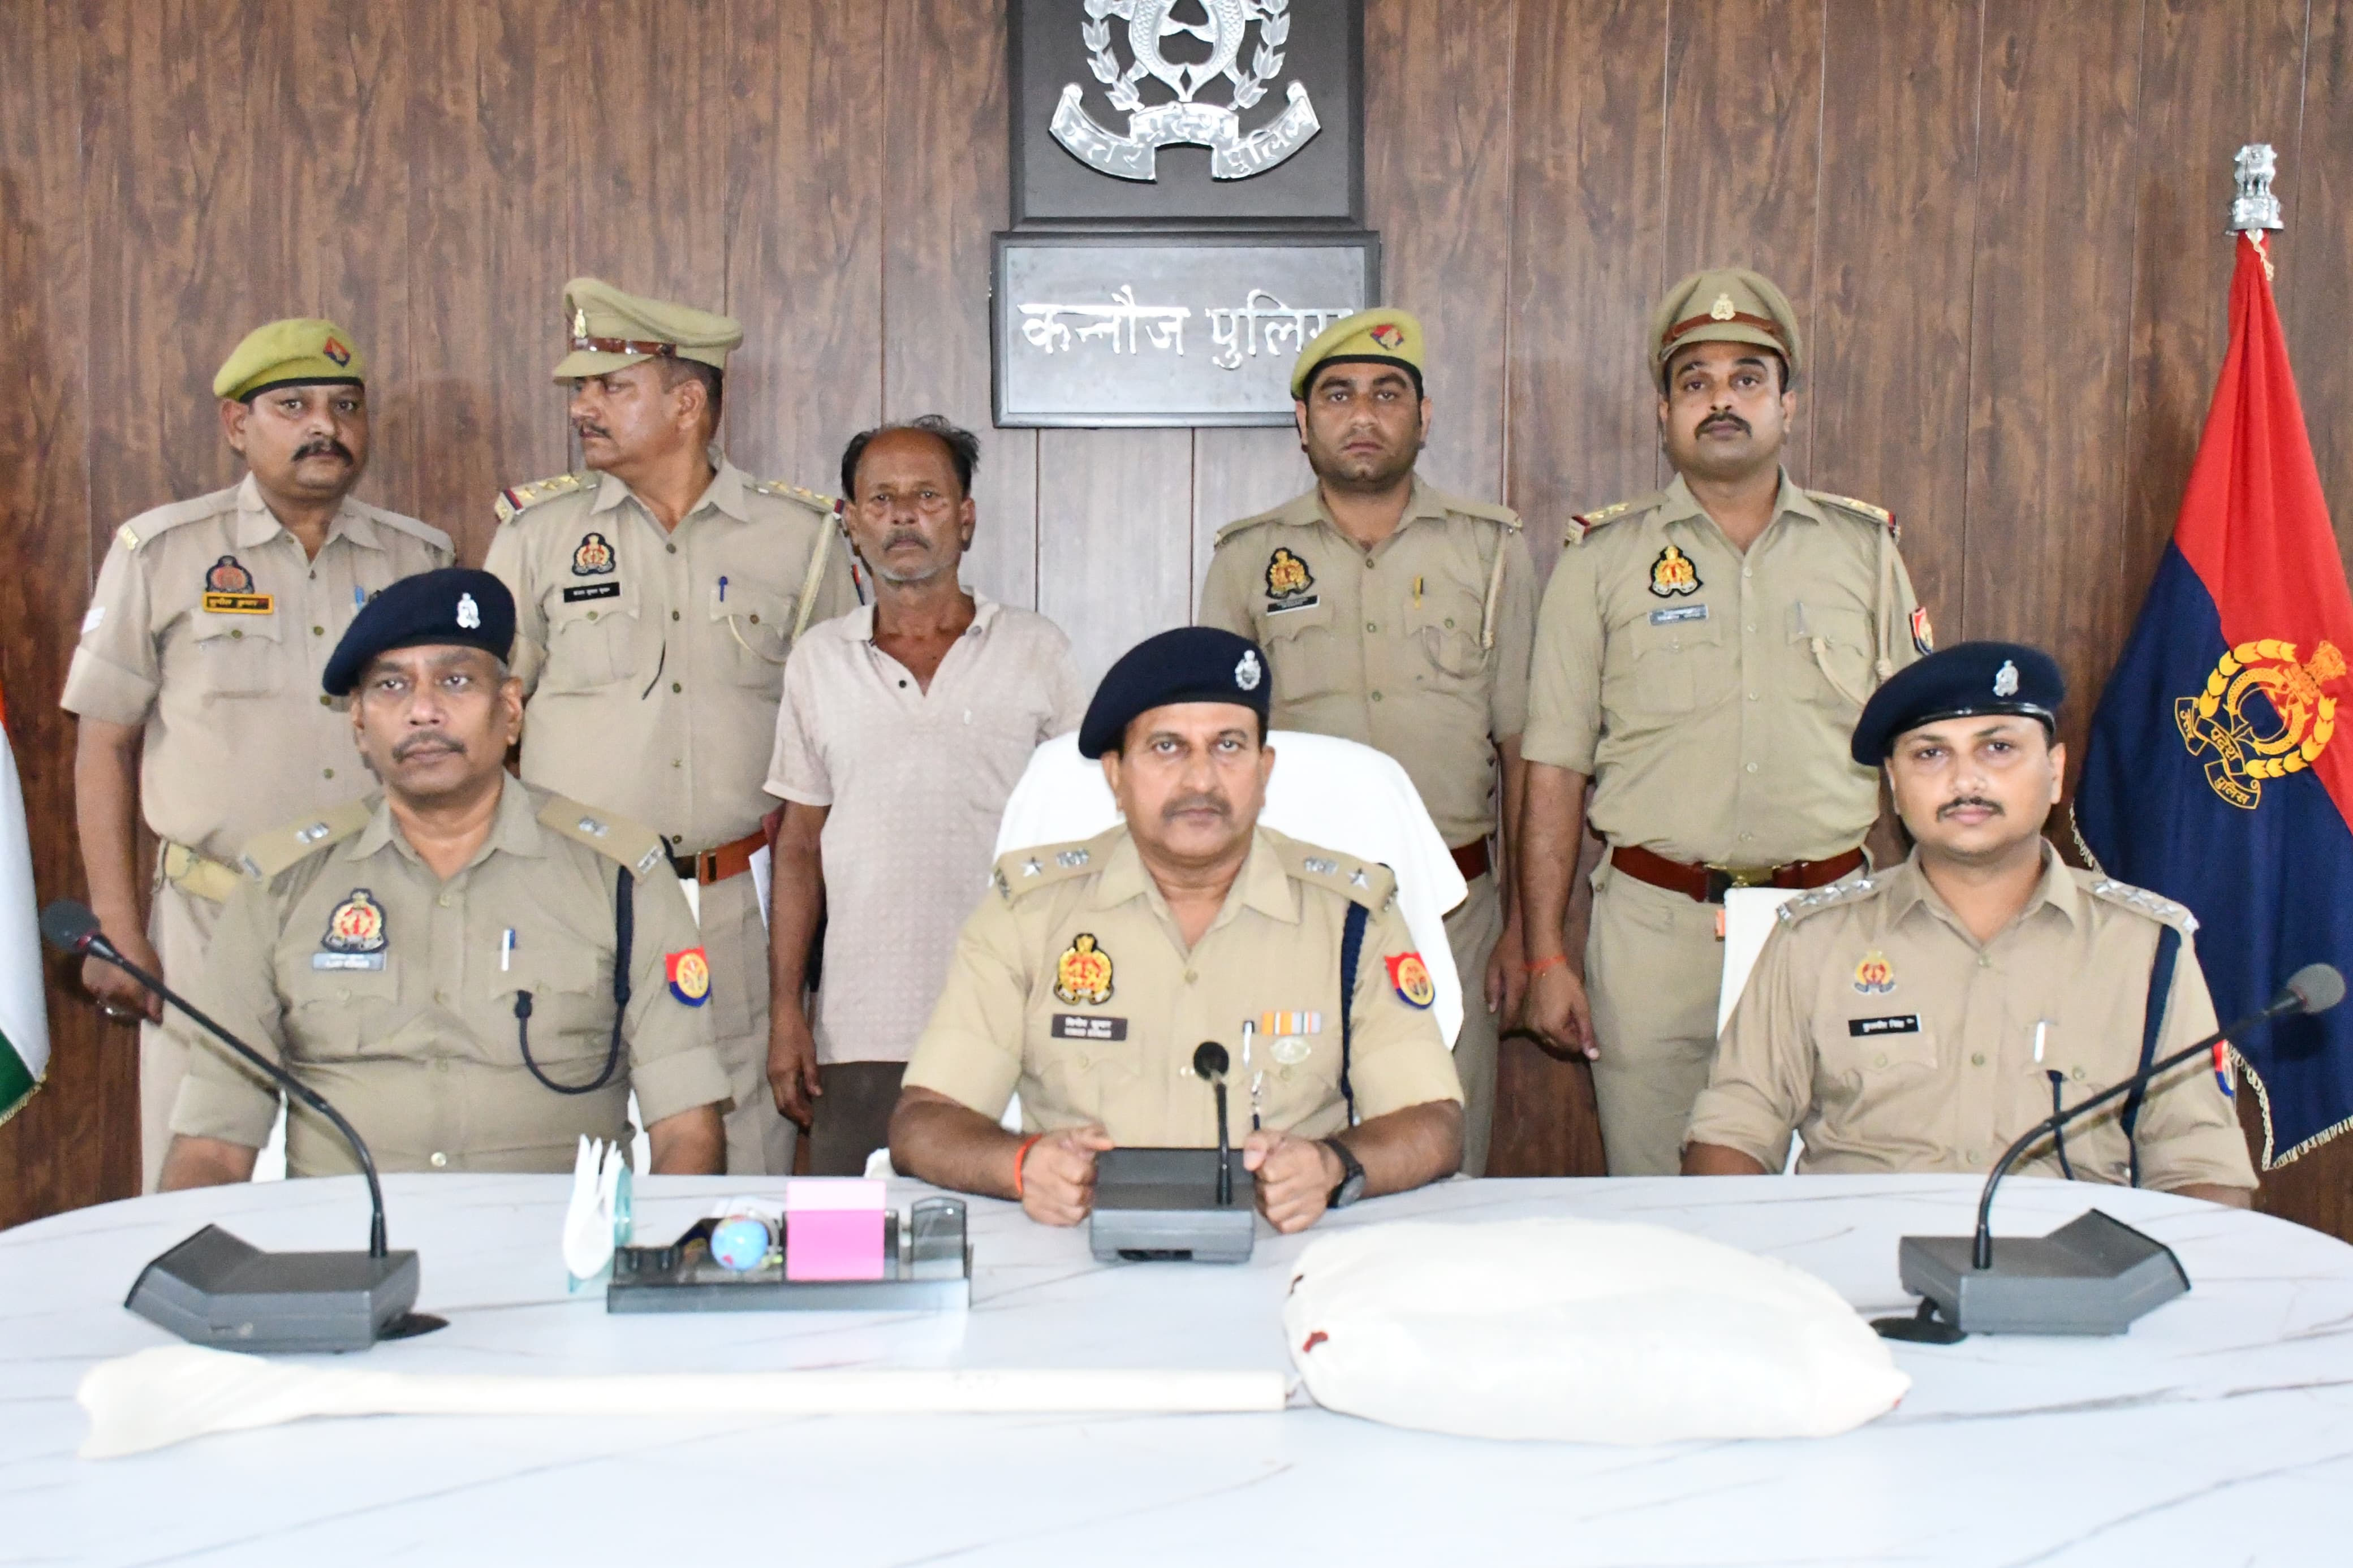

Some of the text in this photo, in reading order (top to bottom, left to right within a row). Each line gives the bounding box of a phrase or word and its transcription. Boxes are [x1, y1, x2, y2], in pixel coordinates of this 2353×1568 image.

[1222, 104, 1312, 175] पुलिस
[1017, 284, 1191, 356] कन्नौज
[2214, 775, 2251, 805] पुलिस
